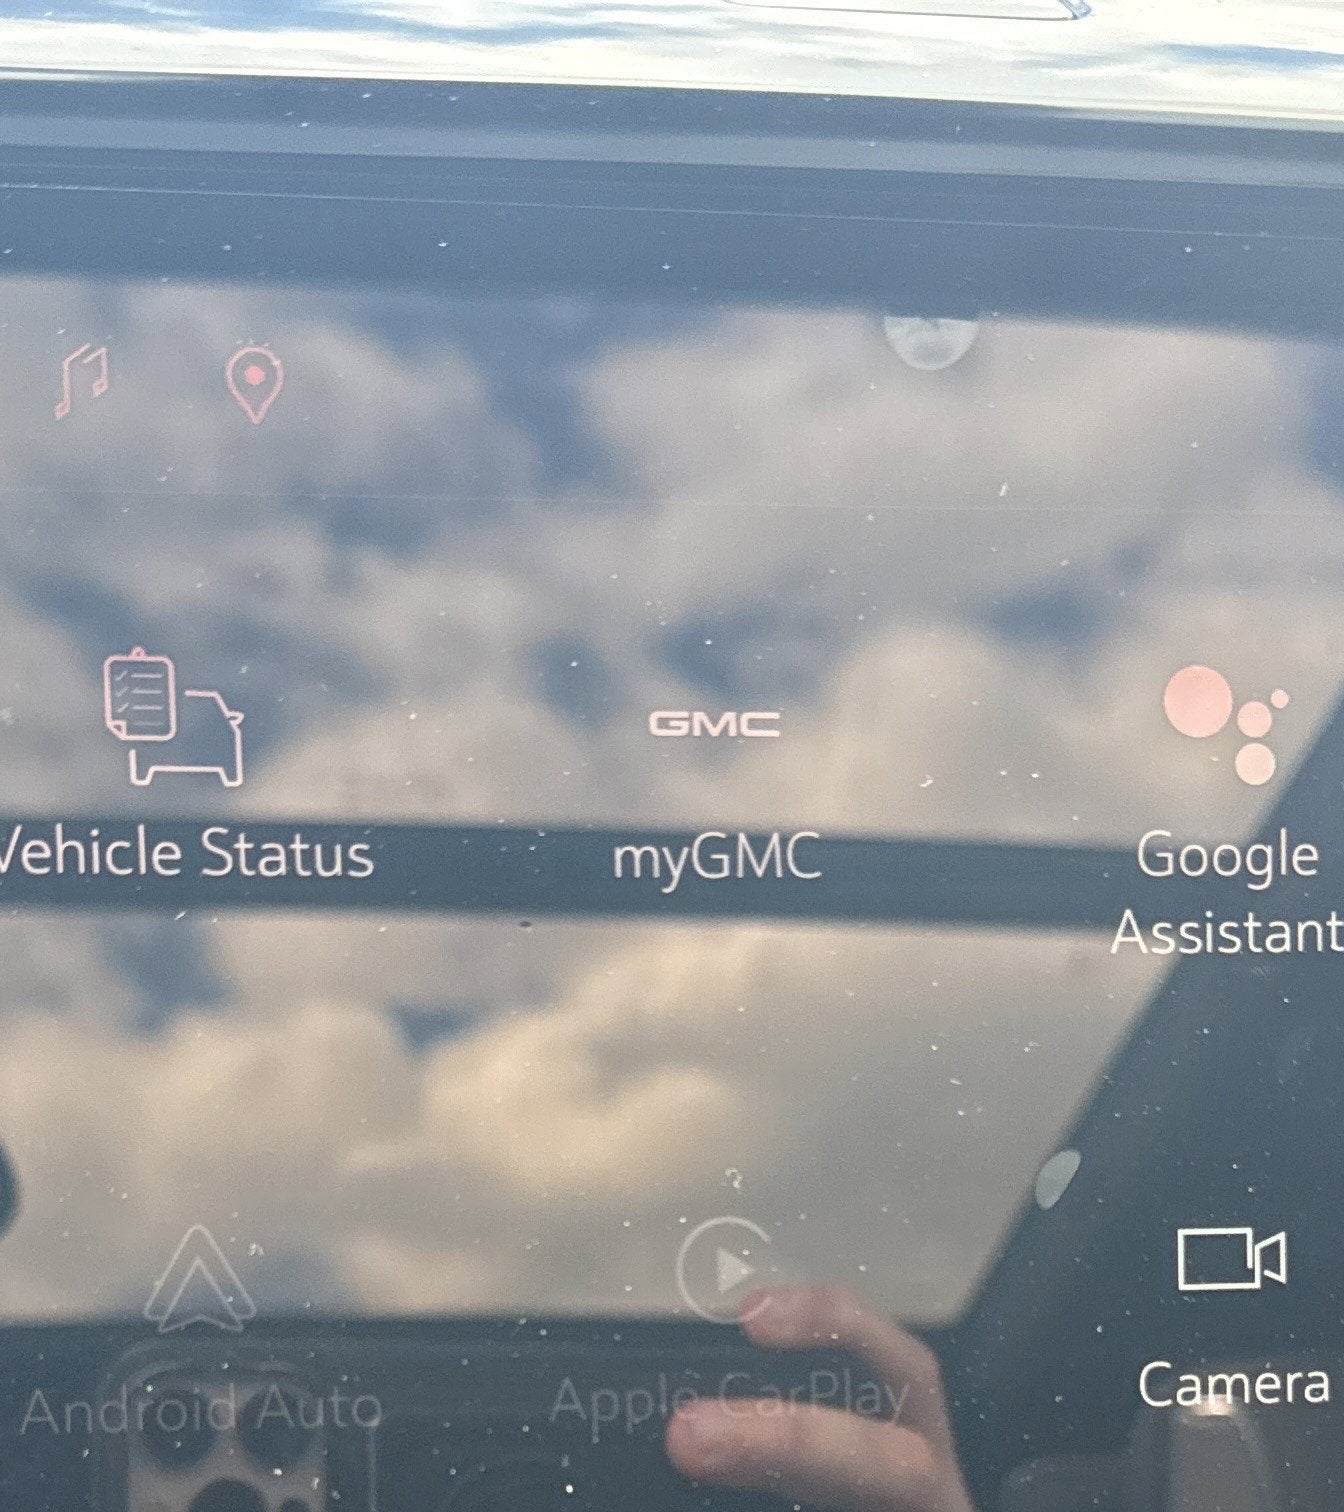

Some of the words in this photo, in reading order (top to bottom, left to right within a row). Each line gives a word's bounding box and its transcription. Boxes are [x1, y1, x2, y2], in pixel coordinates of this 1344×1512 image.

[648, 709, 782, 738] GMC
[200, 826, 375, 879] Status
[612, 830, 824, 894] myGMC
[1136, 828, 1320, 890] Google
[19, 1384, 238, 1436] Android
[256, 1384, 384, 1430] Auto
[549, 1375, 699, 1432] Apple
[717, 1366, 912, 1424] CarPlay
[1138, 1359, 1332, 1408] Camera
